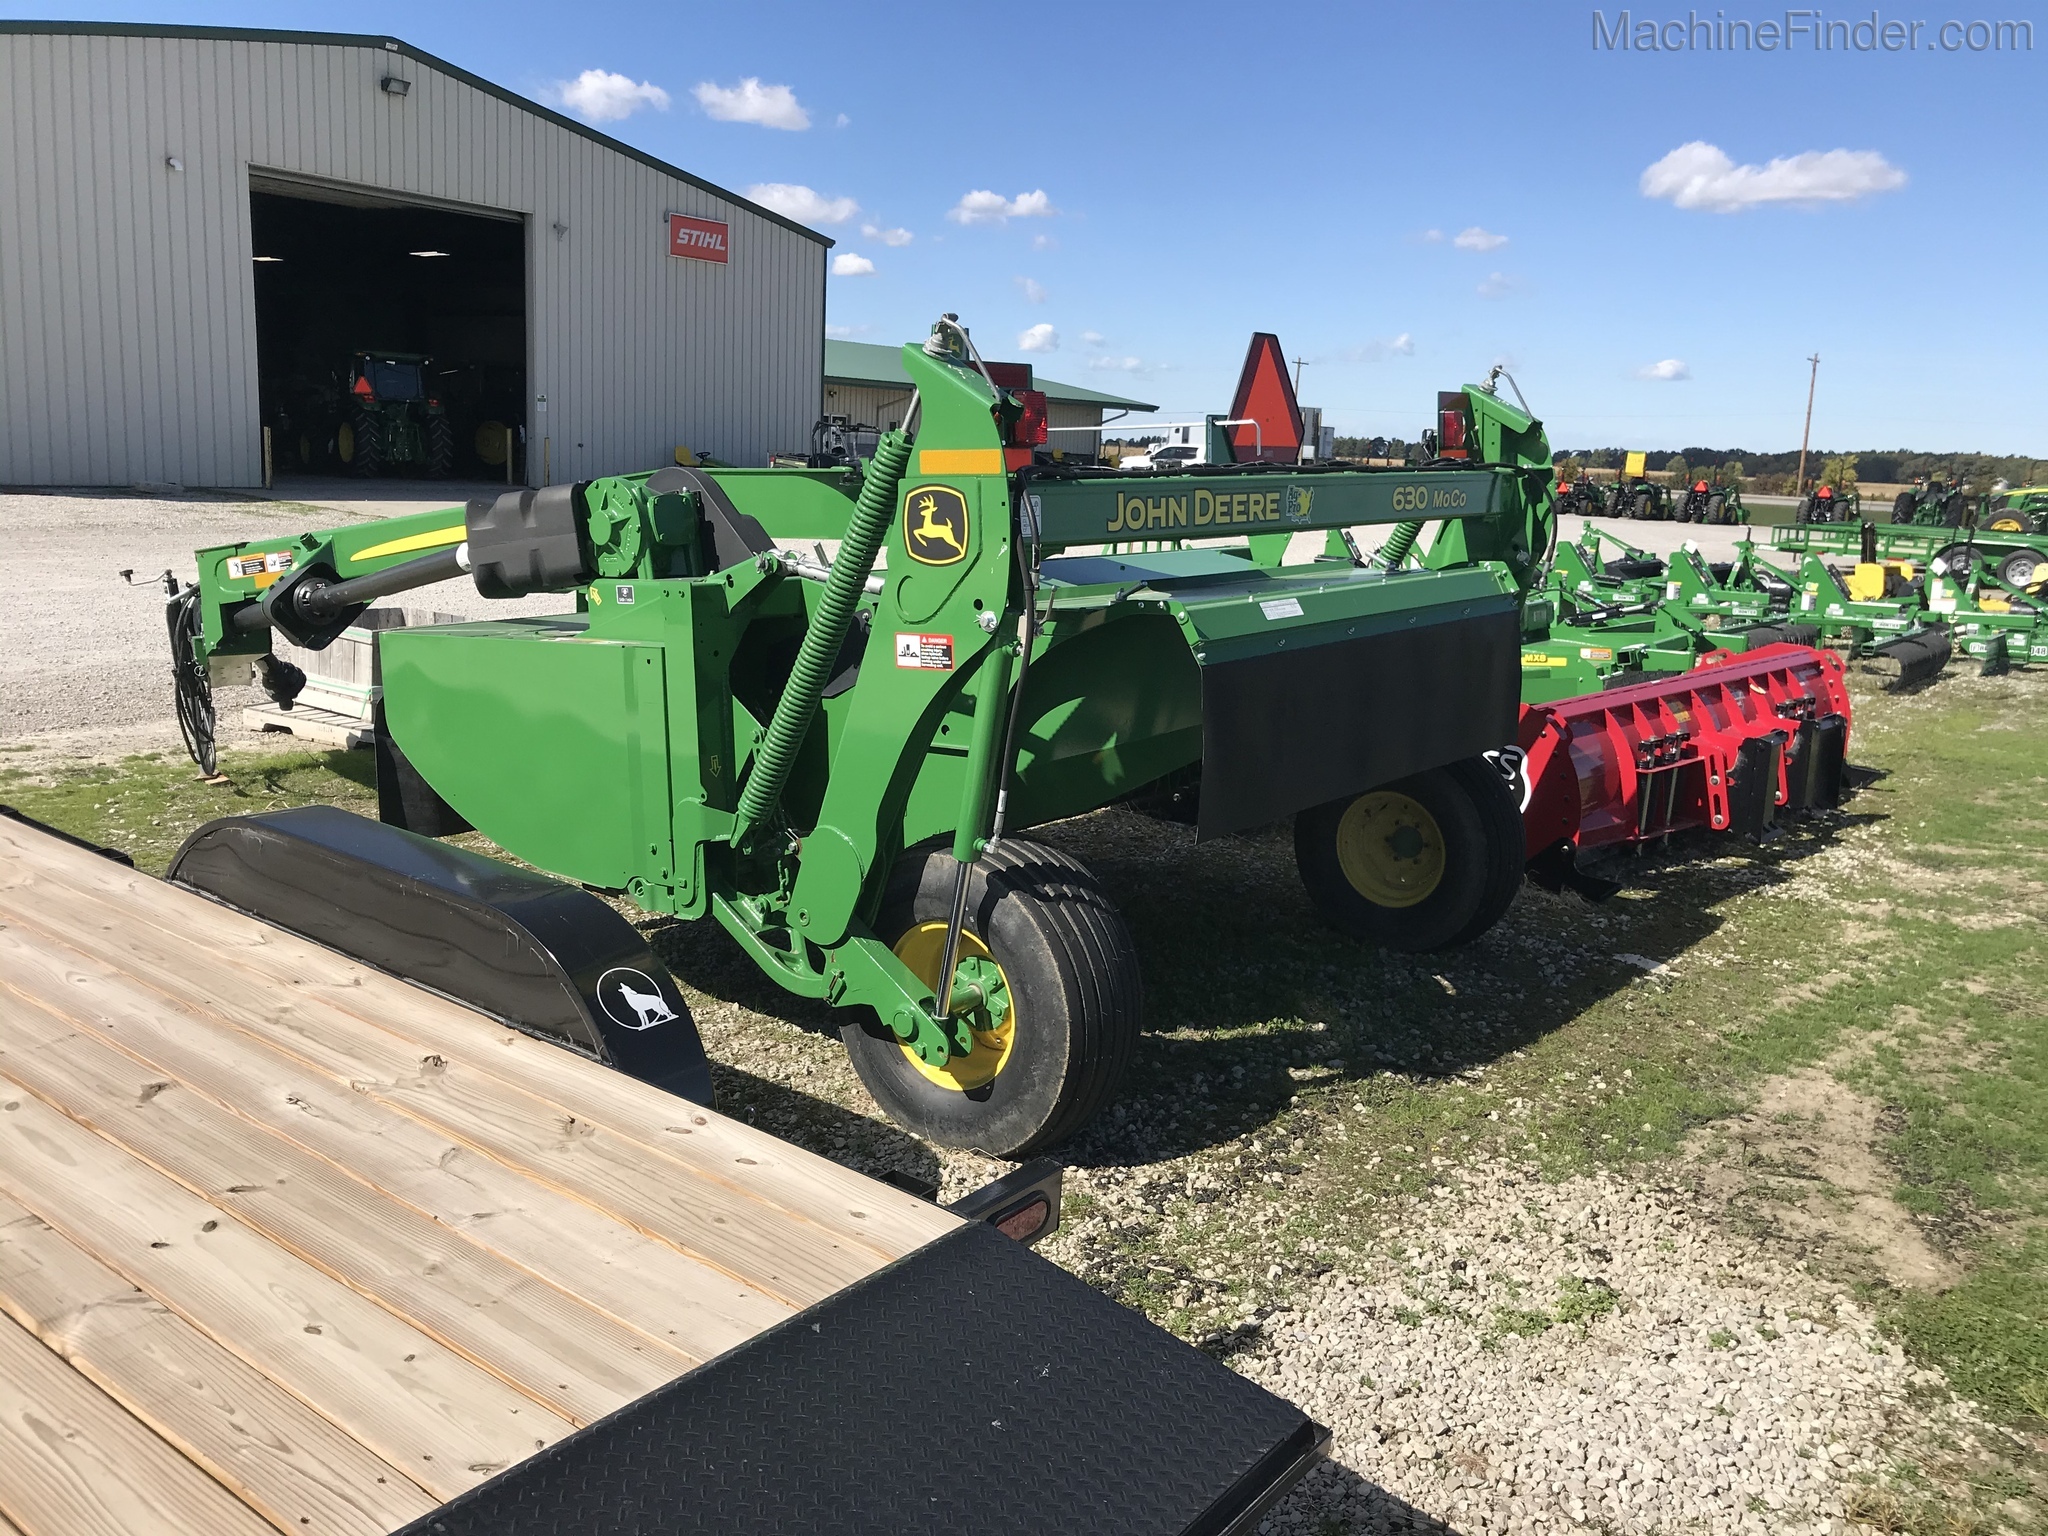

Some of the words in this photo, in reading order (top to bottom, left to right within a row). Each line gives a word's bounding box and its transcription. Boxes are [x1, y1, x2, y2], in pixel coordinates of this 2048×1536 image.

[676, 228, 726, 251] STIHL
[1107, 490, 1188, 532] JOHN
[1194, 488, 1281, 526] DEERE
[1392, 485, 1428, 511] 630
[1432, 489, 1467, 508] MoCo
